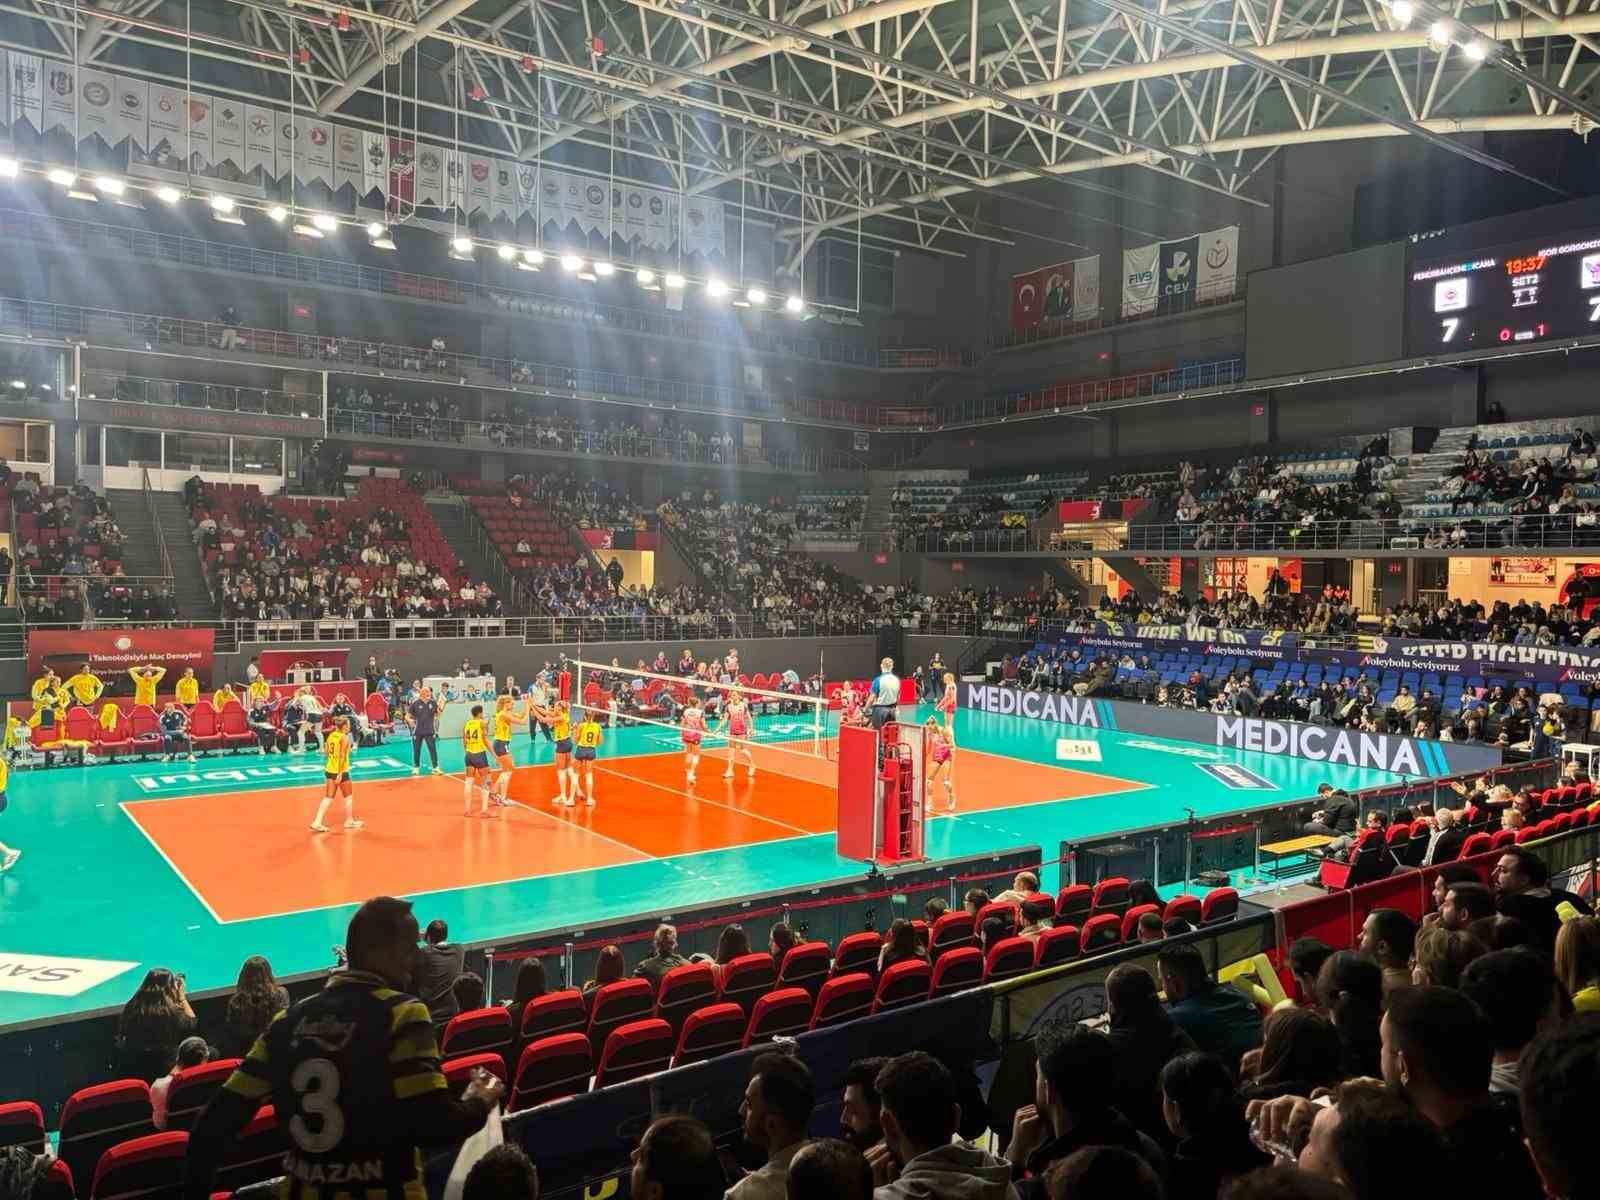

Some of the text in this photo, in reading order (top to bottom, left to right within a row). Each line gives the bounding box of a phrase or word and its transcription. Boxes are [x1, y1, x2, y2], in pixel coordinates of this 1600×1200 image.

[1506, 256, 1547, 275] 19:37
[1165, 281, 1189, 295] CEV
[1442, 317, 1459, 342] 7
[1500, 328, 1511, 341] 0
[1537, 323, 1545, 336] 1
[1207, 646, 1284, 660] Voleybolu Seviyoruz
[1365, 656, 1461, 673] Voleybolu Seviyoruz
[967, 683, 1099, 728] MEDICANA
[586, 731, 594, 744] 8
[1215, 715, 1421, 776] MEDICANA
[137, 757, 404, 788] Isanbul
[288, 1057, 346, 1153] 3
